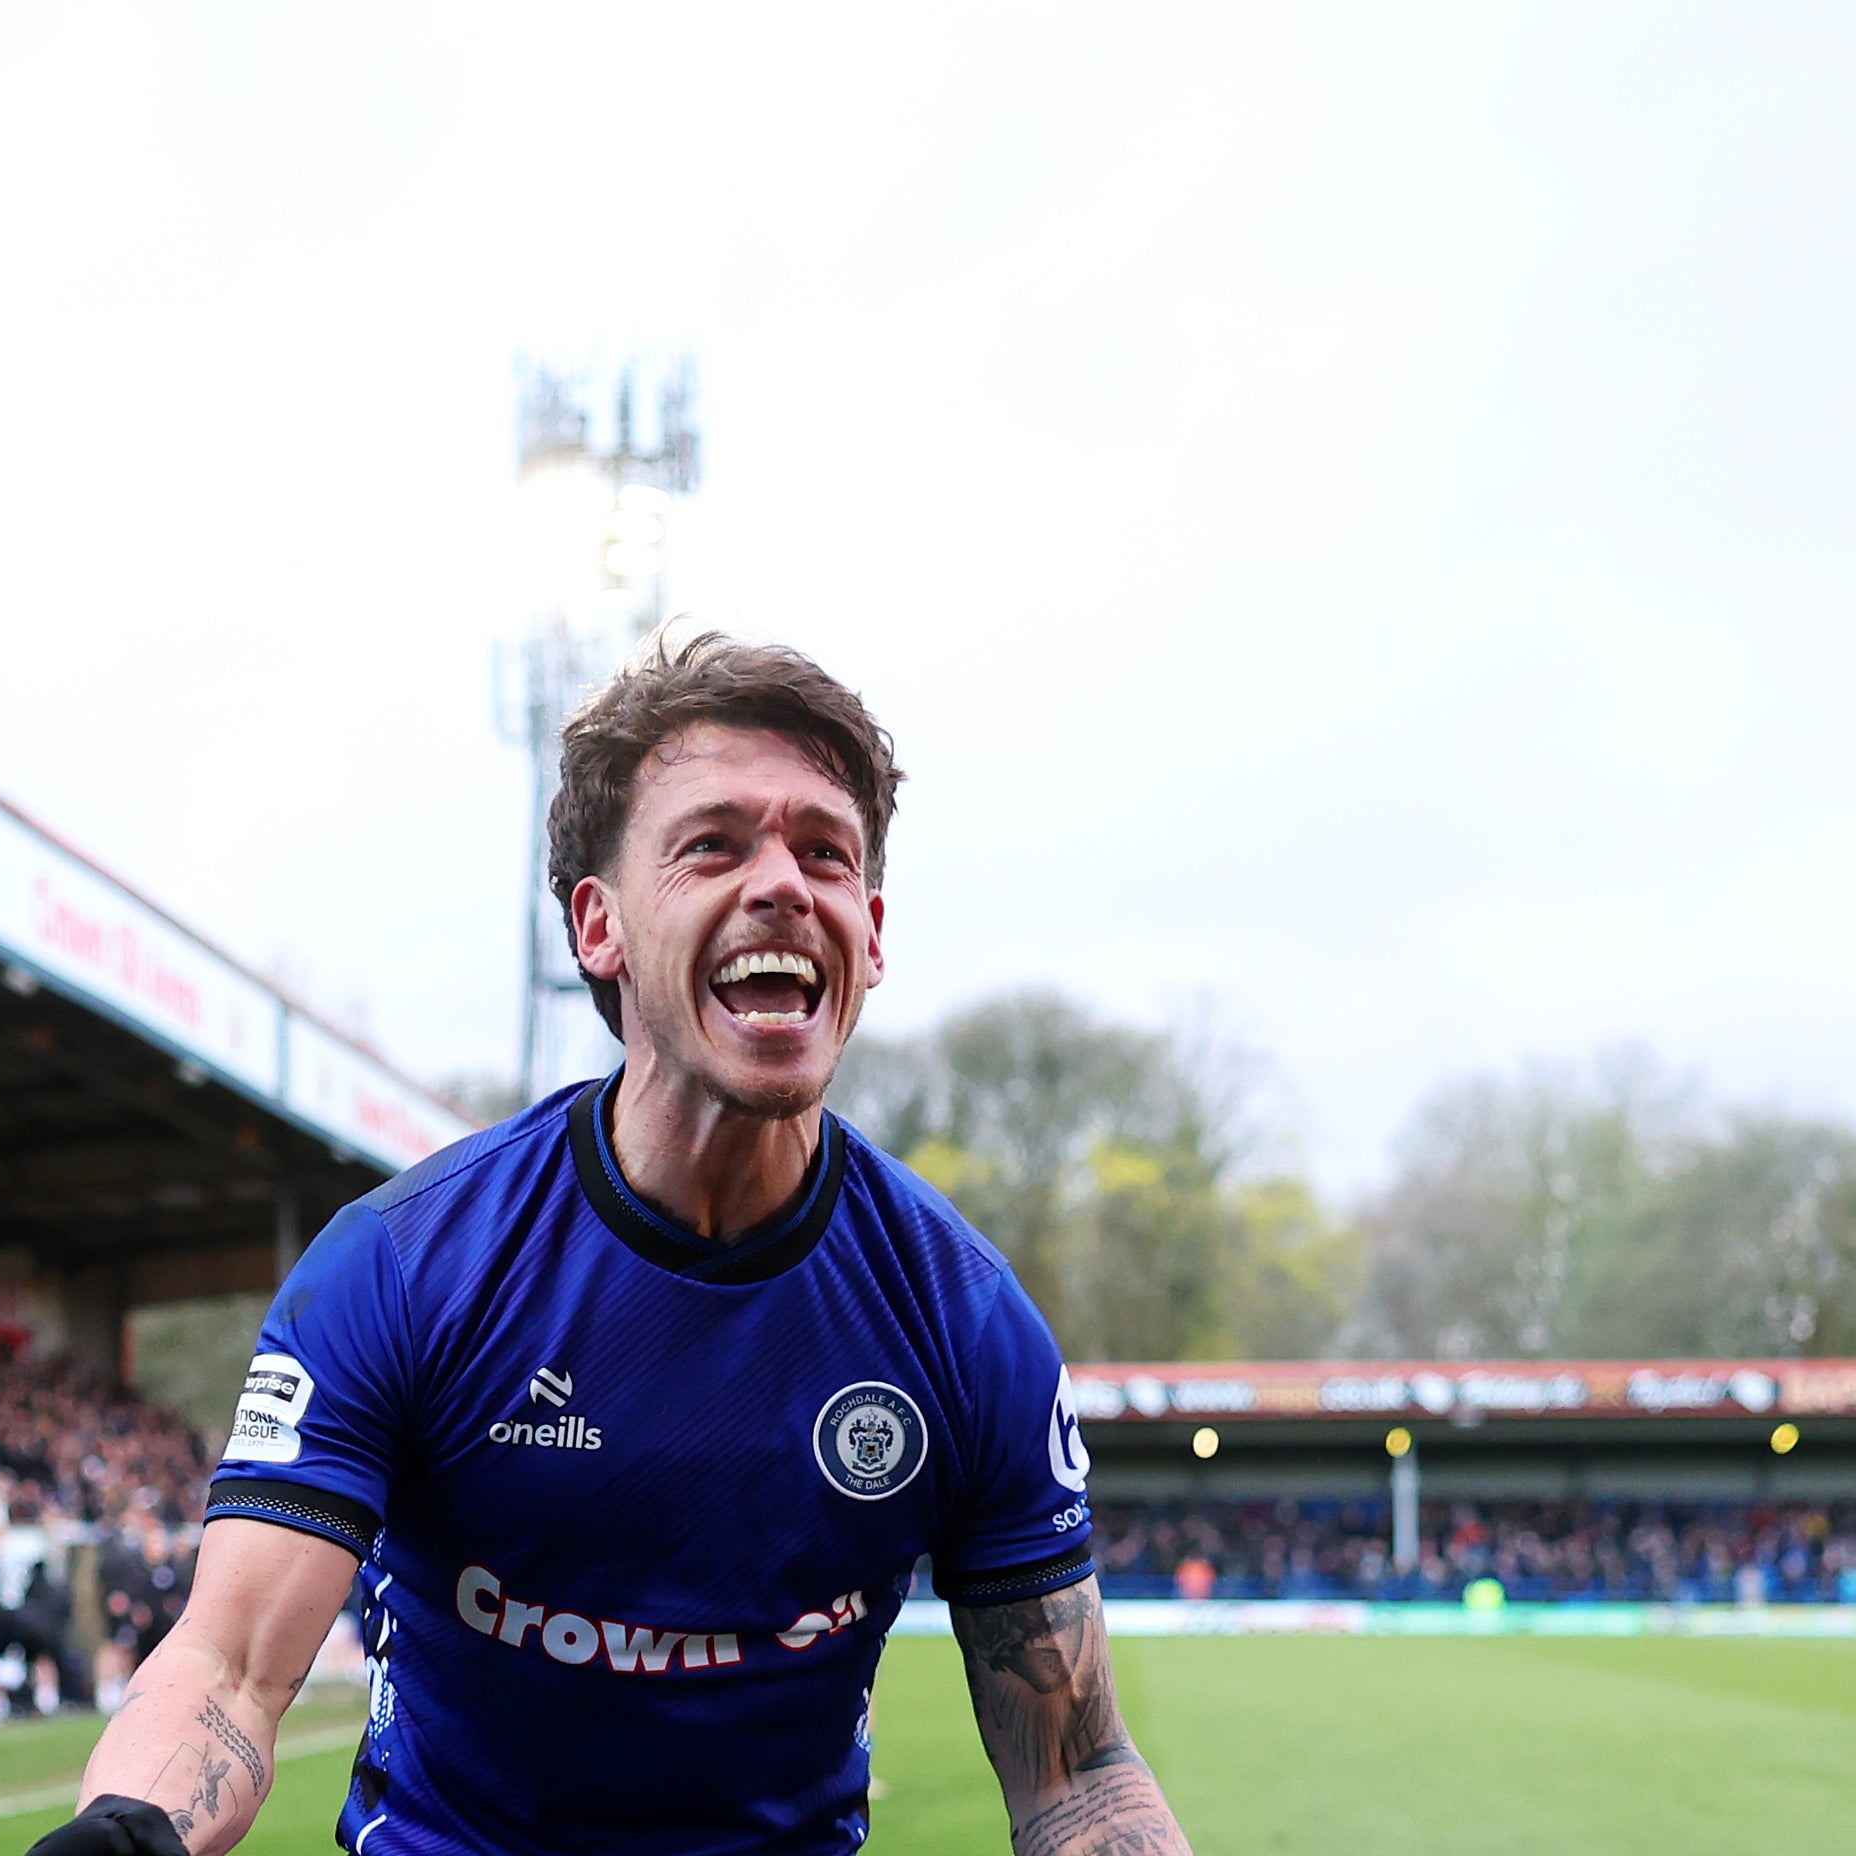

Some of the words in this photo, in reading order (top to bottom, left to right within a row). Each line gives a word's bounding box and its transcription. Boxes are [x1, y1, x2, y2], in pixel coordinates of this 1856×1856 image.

[829, 1393, 887, 1427] ROCHDALE
[232, 1423, 279, 1440] EAGUE
[844, 1473, 864, 1489] THE
[865, 1475, 892, 1490] DALE
[456, 1563, 742, 1673] Crown
